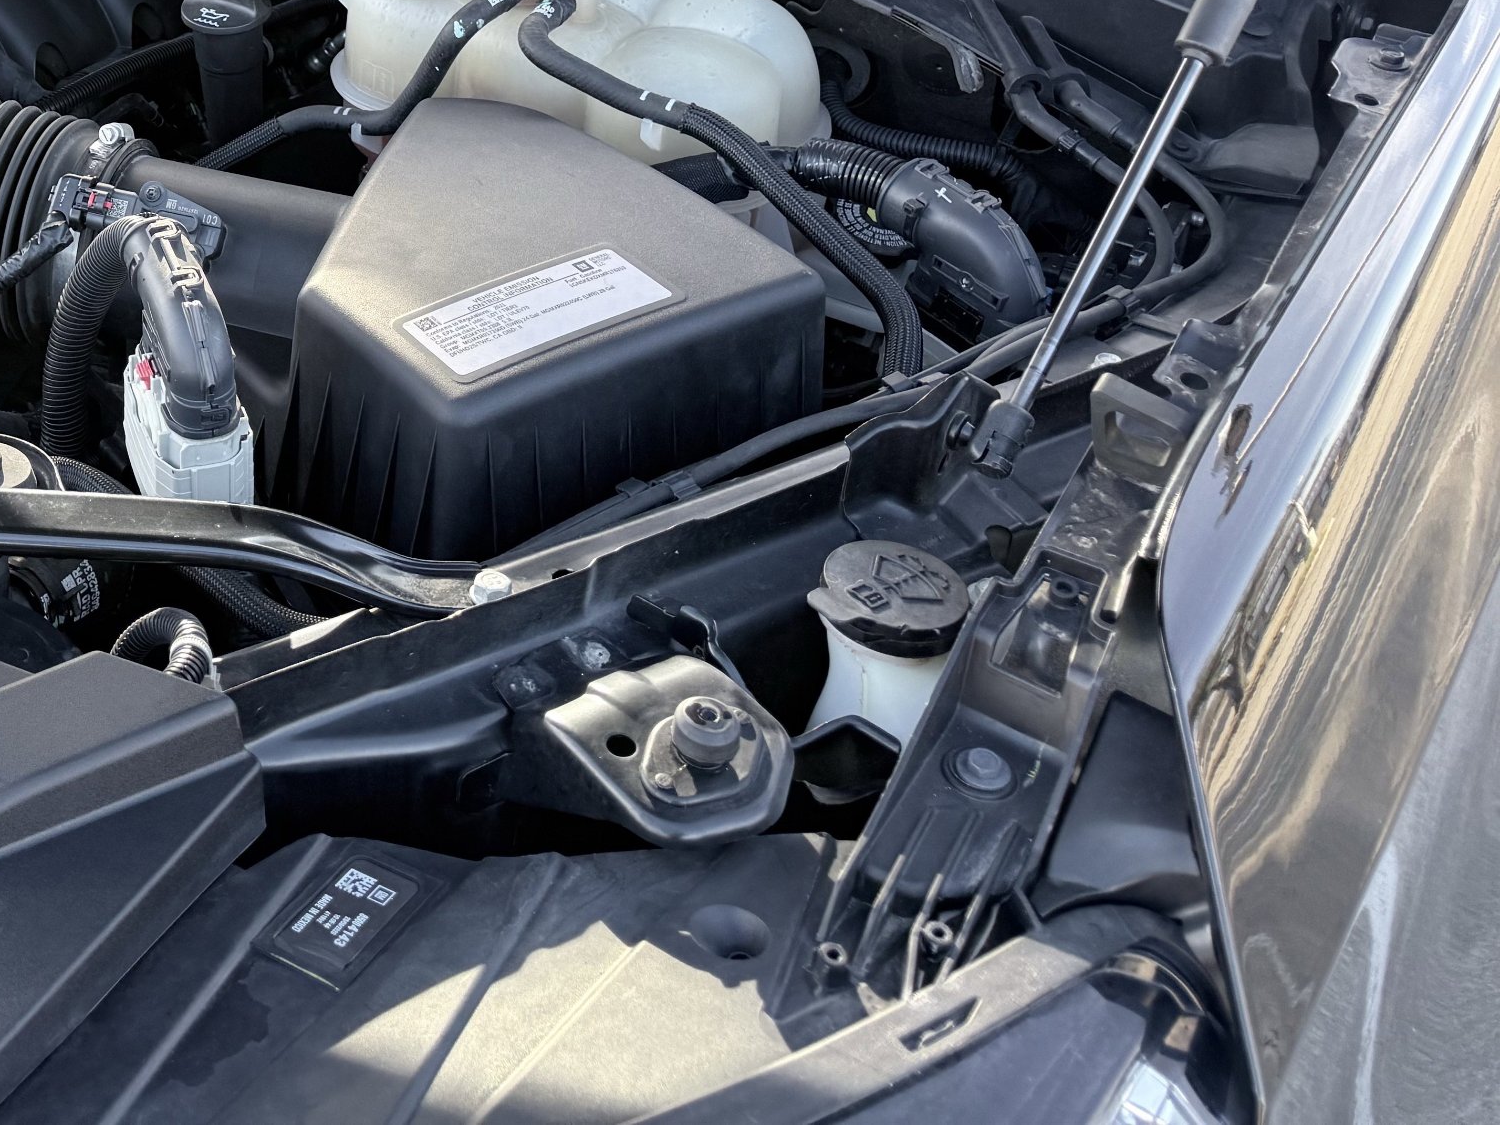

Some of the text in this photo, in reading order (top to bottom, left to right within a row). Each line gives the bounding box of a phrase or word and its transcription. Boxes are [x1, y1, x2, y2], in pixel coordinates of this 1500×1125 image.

[468, 278, 553, 311] CONTROL INFORMATION
[315, 894, 332, 909] MADE
[292, 913, 313, 932] MEXICO
